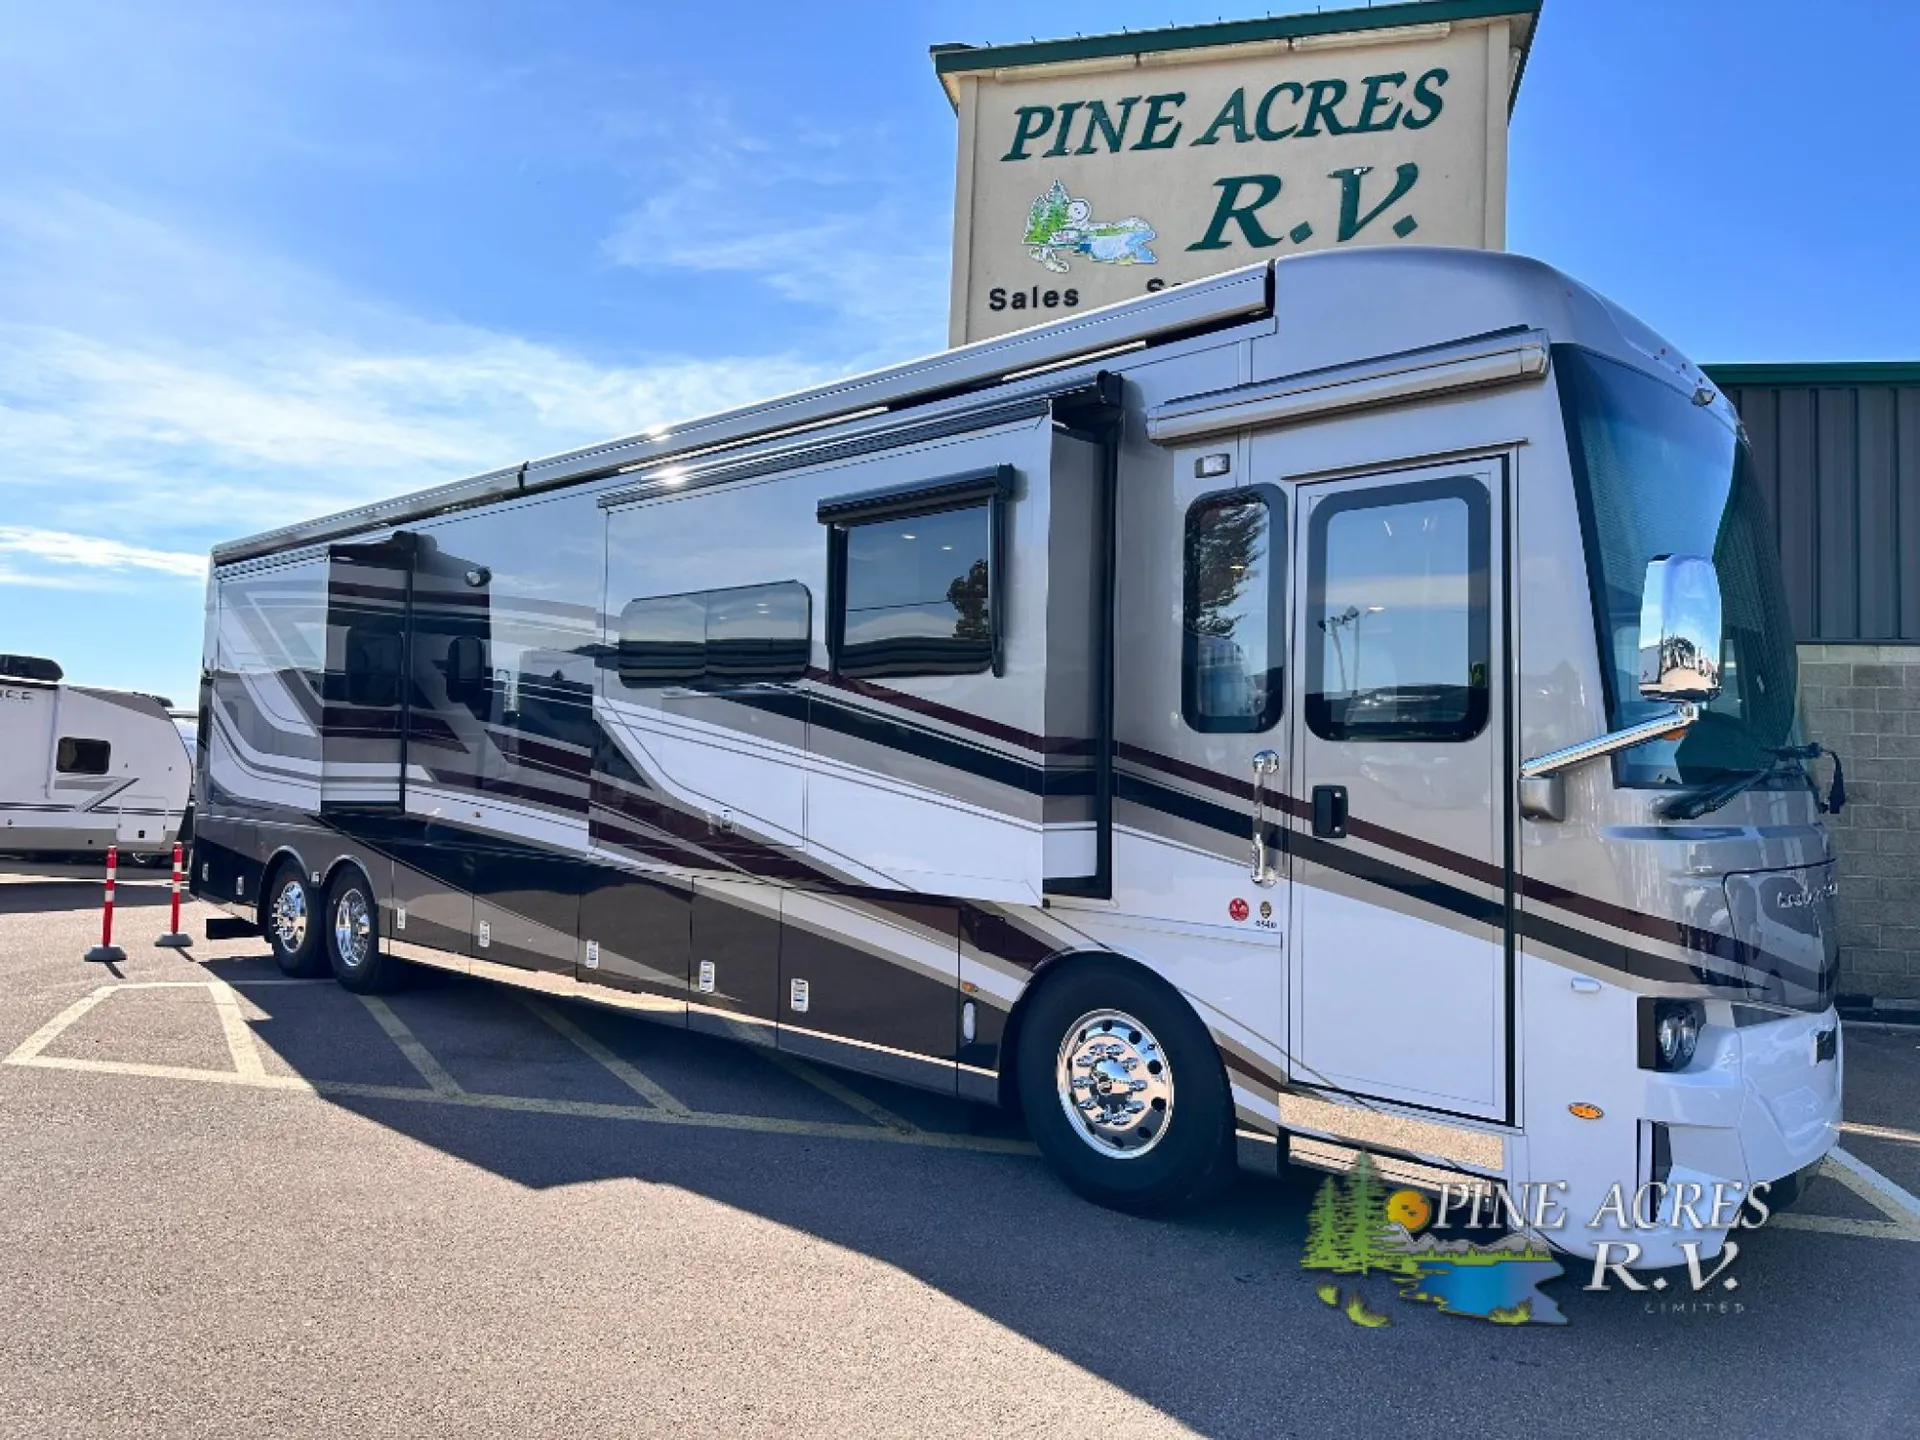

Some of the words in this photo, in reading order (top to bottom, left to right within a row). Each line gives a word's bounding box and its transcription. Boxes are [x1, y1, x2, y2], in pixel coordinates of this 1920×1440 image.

[1001, 92, 1186, 162] PINE
[1189, 68, 1449, 147] ACRES
[1185, 162, 1420, 252] R.V.
[988, 285, 1080, 312] Sales
